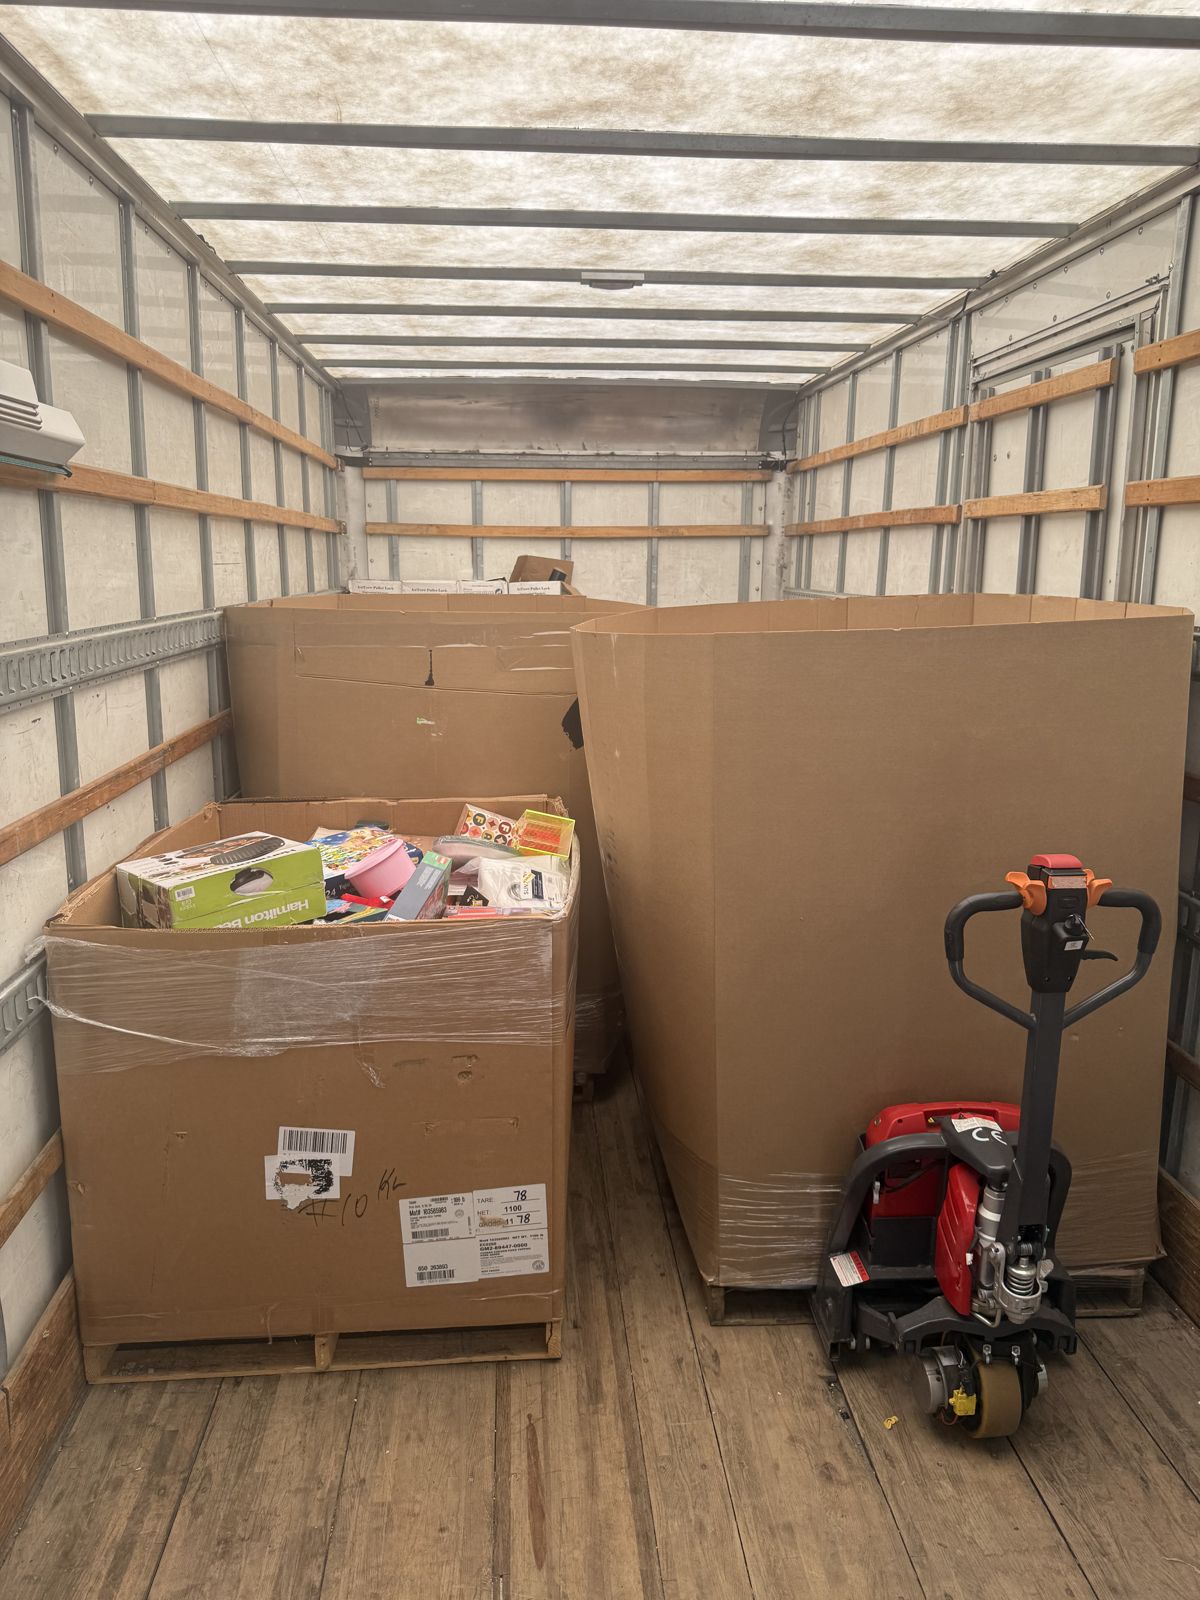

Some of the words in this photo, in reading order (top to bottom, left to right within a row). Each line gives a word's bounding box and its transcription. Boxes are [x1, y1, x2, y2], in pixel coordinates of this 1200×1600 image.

[244, 899, 309, 924] Hamilton
[972, 1127, 1008, 1146] CE
[513, 1190, 527, 1201] 78
[516, 1213, 531, 1224] 78
